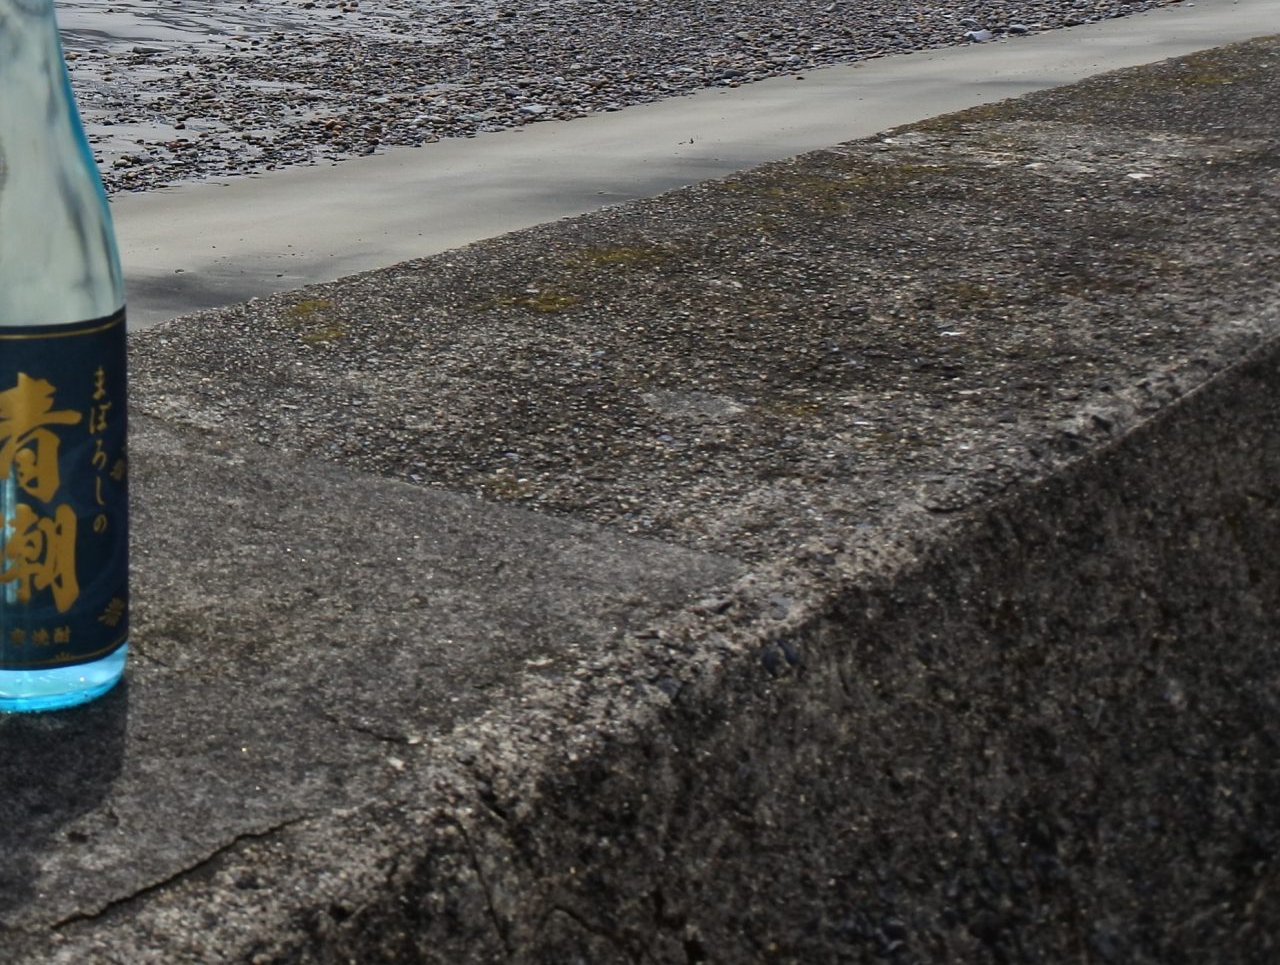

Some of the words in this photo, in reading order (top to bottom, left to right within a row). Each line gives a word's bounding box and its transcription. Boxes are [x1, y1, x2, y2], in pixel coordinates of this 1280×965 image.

[89, 366, 112, 533] まぼろしの
